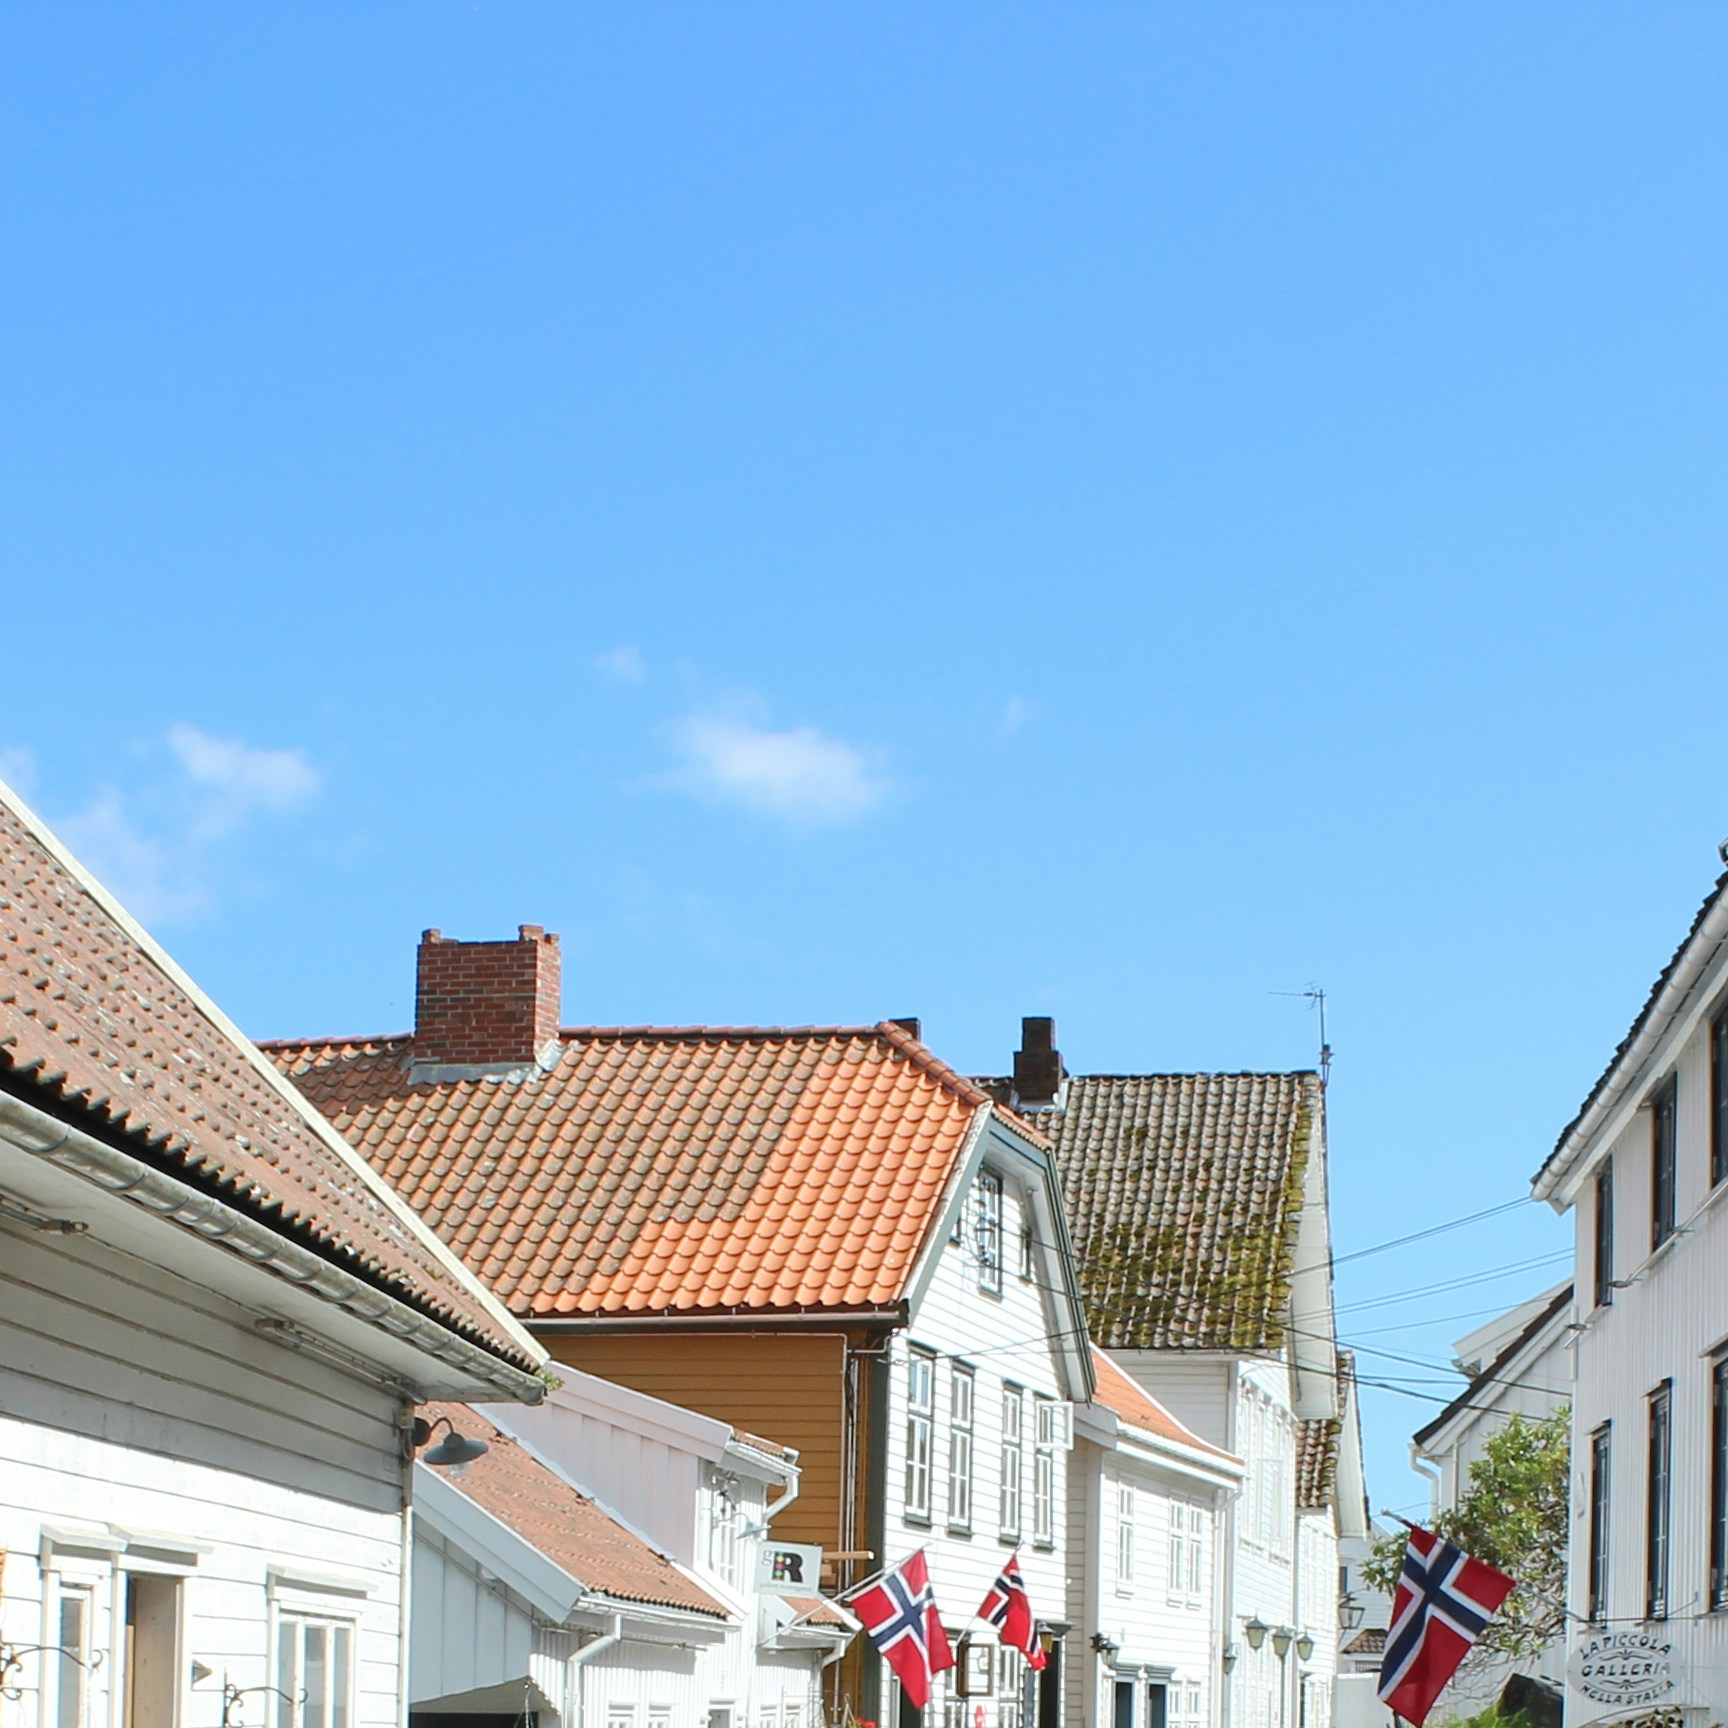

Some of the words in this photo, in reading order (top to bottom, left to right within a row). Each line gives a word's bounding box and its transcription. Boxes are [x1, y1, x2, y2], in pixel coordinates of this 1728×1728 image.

[1580, 1641, 1599, 1660] LA
[1603, 1635, 1671, 1655] PICCOLA
[1581, 1663, 1670, 1677] GALLERIA
[1581, 1685, 1622, 1703] NELLA
